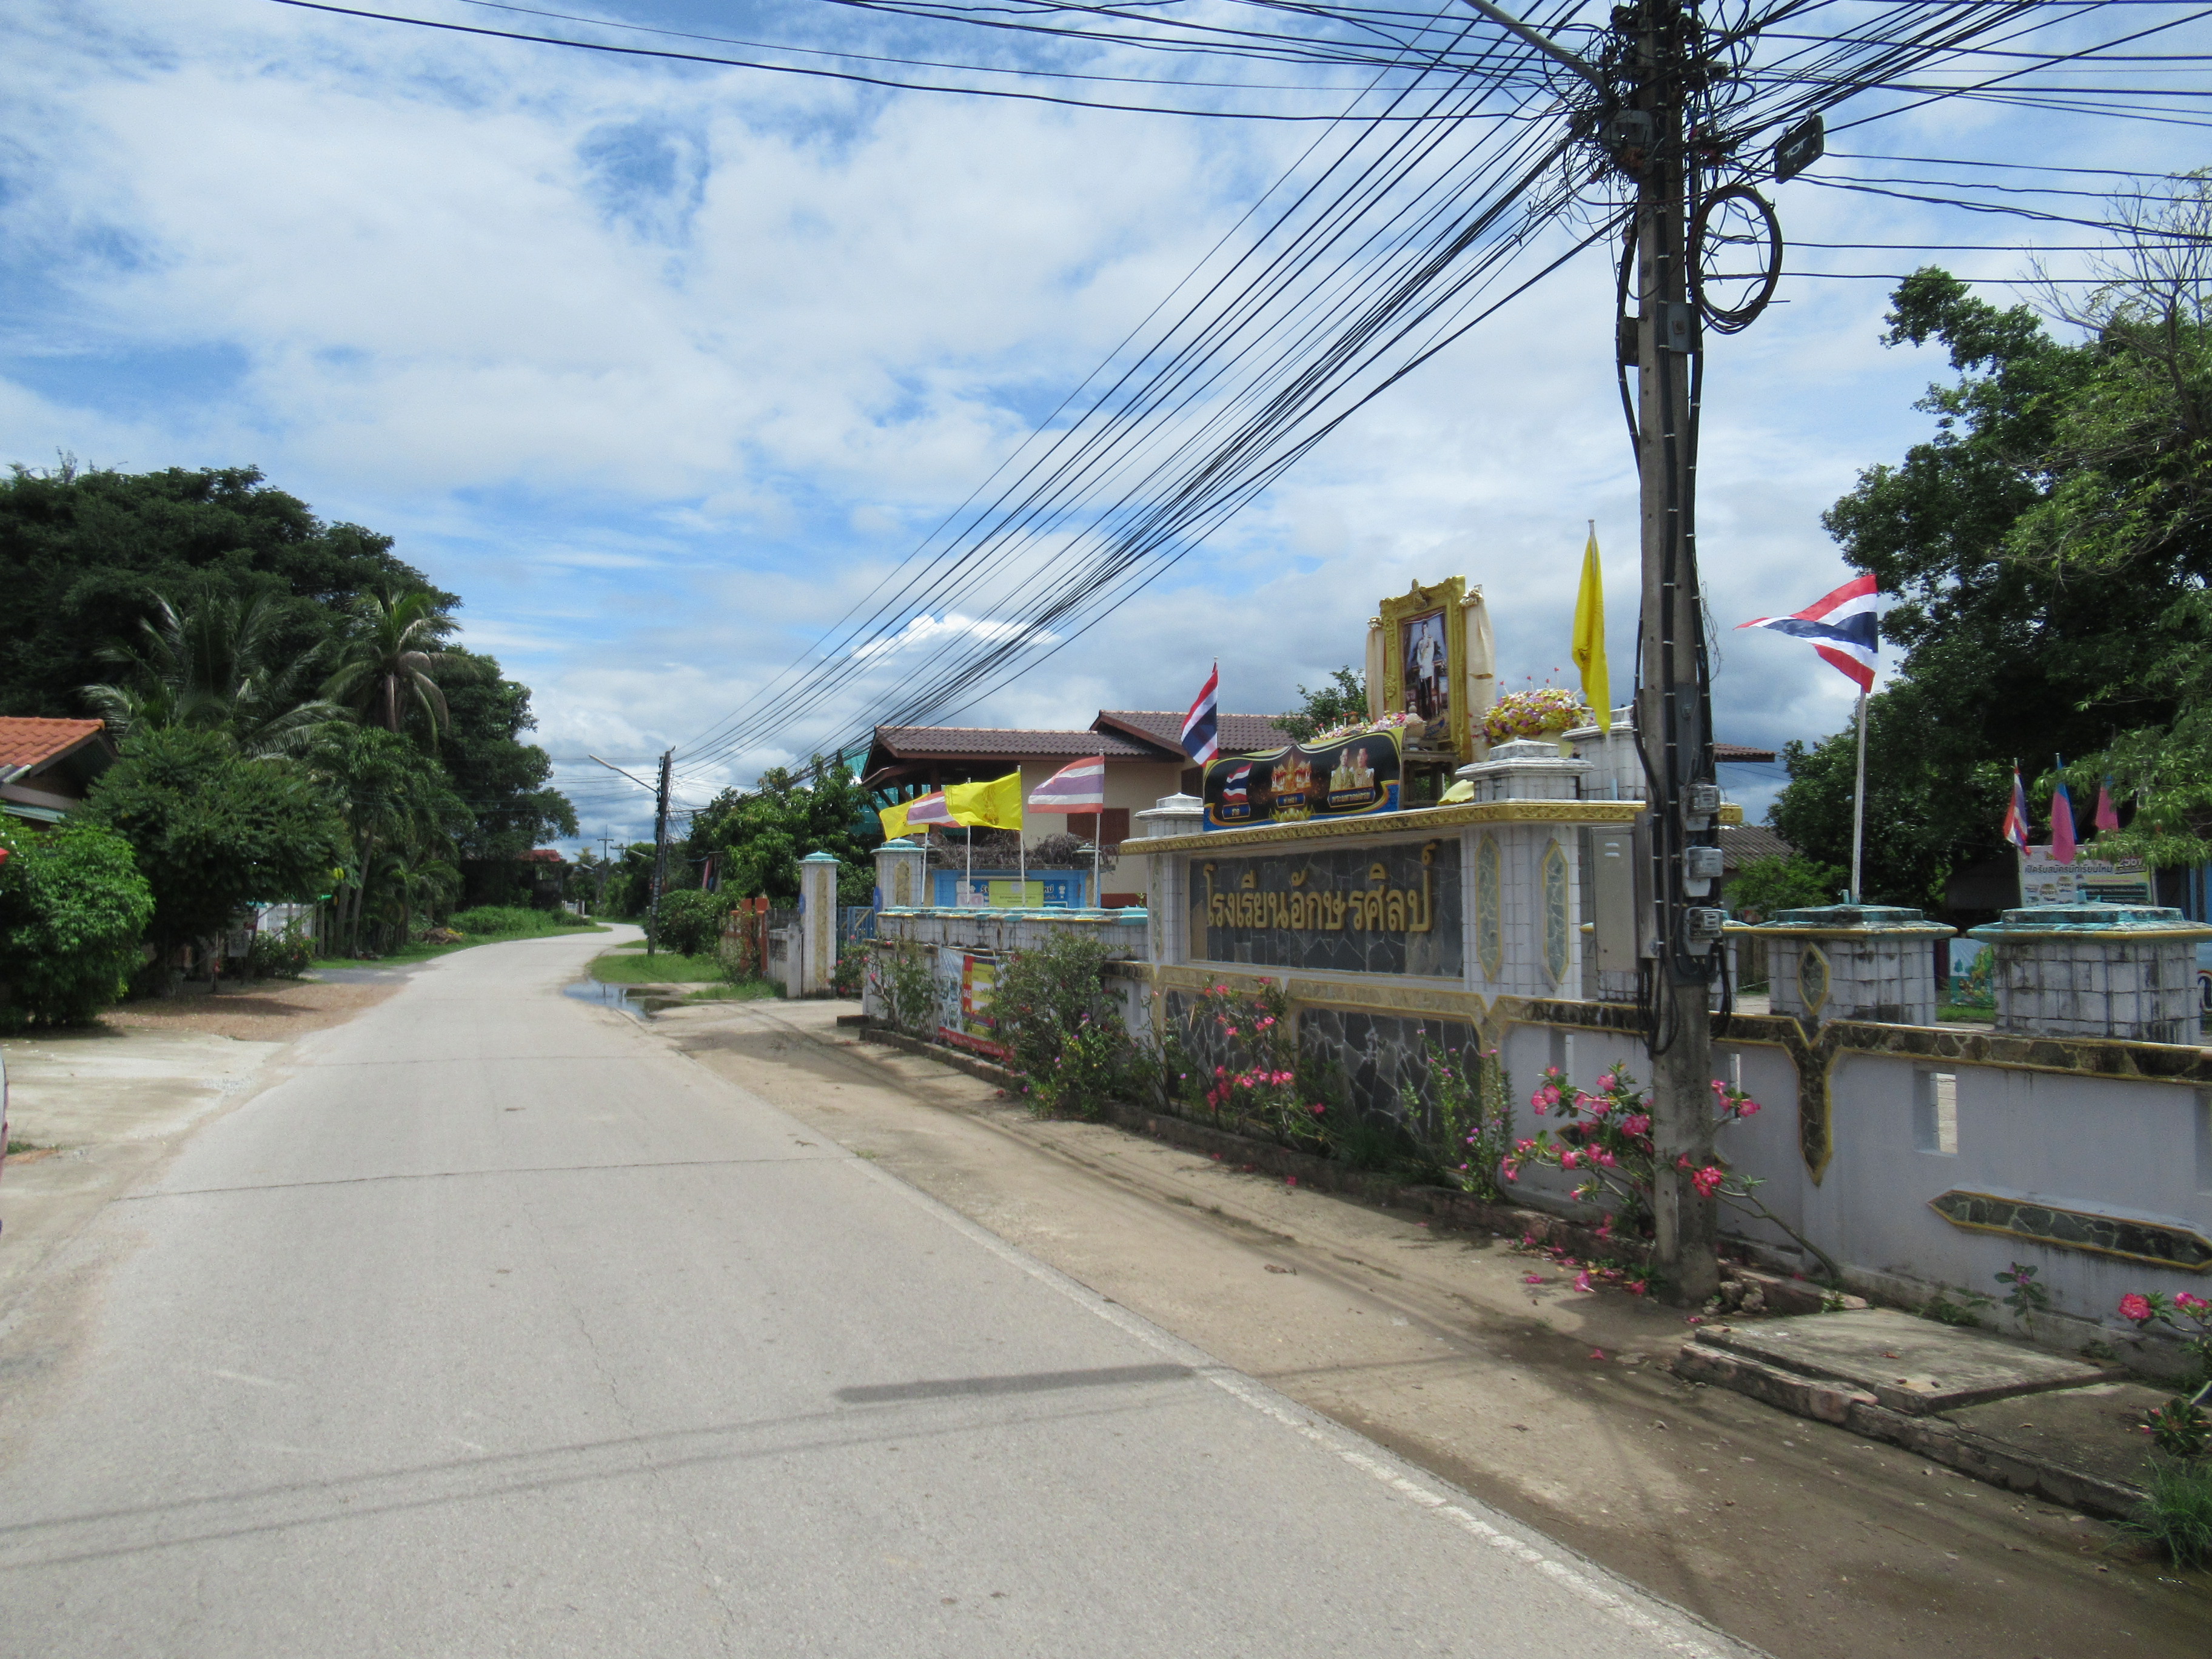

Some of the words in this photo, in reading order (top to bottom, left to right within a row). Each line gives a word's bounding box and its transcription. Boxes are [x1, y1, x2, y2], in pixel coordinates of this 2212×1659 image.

[1782, 137, 1808, 159] TOT
[1203, 842, 1437, 933] โรงเรียนอักษรศิลป์
